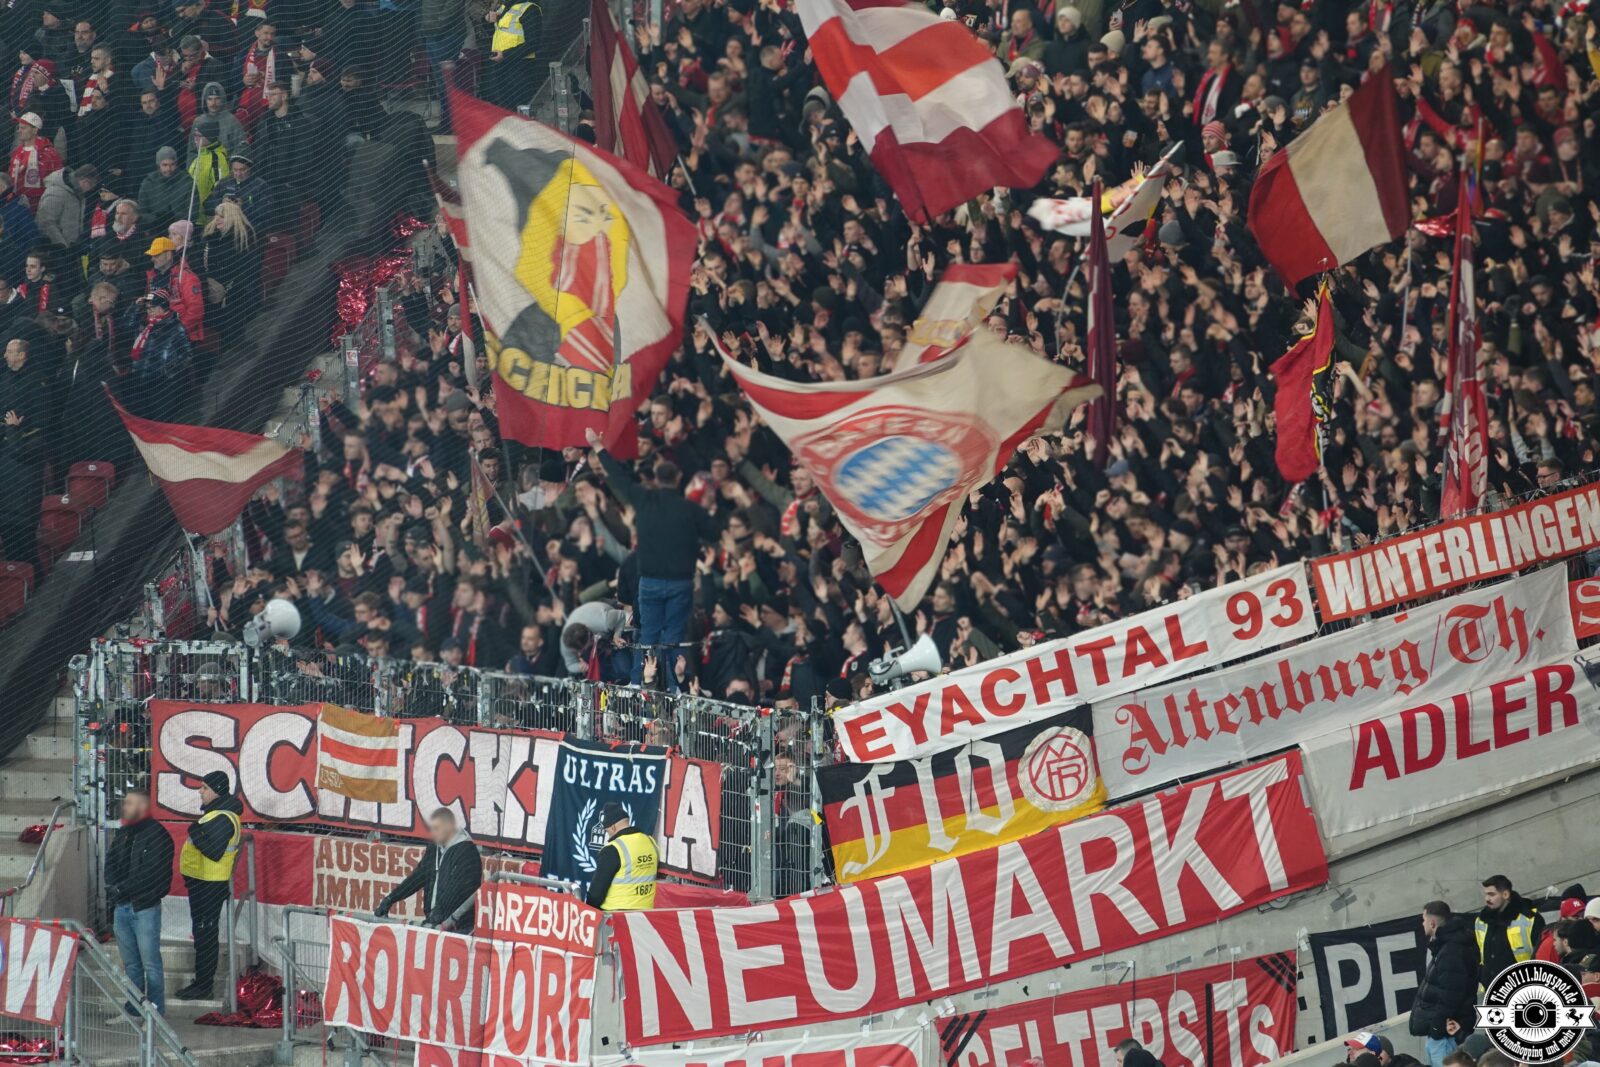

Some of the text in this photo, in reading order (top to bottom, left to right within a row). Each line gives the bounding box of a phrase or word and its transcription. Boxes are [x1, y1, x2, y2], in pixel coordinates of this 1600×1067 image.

[1318, 489, 1600, 616] WINTERLINGEN
[843, 578, 1304, 762] EYACHTAL 93
[1349, 664, 1579, 791] ADLER
[563, 754, 657, 794] ULTRAS
[624, 757, 1289, 1038] NEUMARKT
[634, 884, 653, 896] 1687
[637, 854, 653, 864] SDS
[477, 889, 596, 948] HARZBURG
[324, 916, 595, 1063] ROHRDORF
[1323, 931, 1432, 1037] PF
